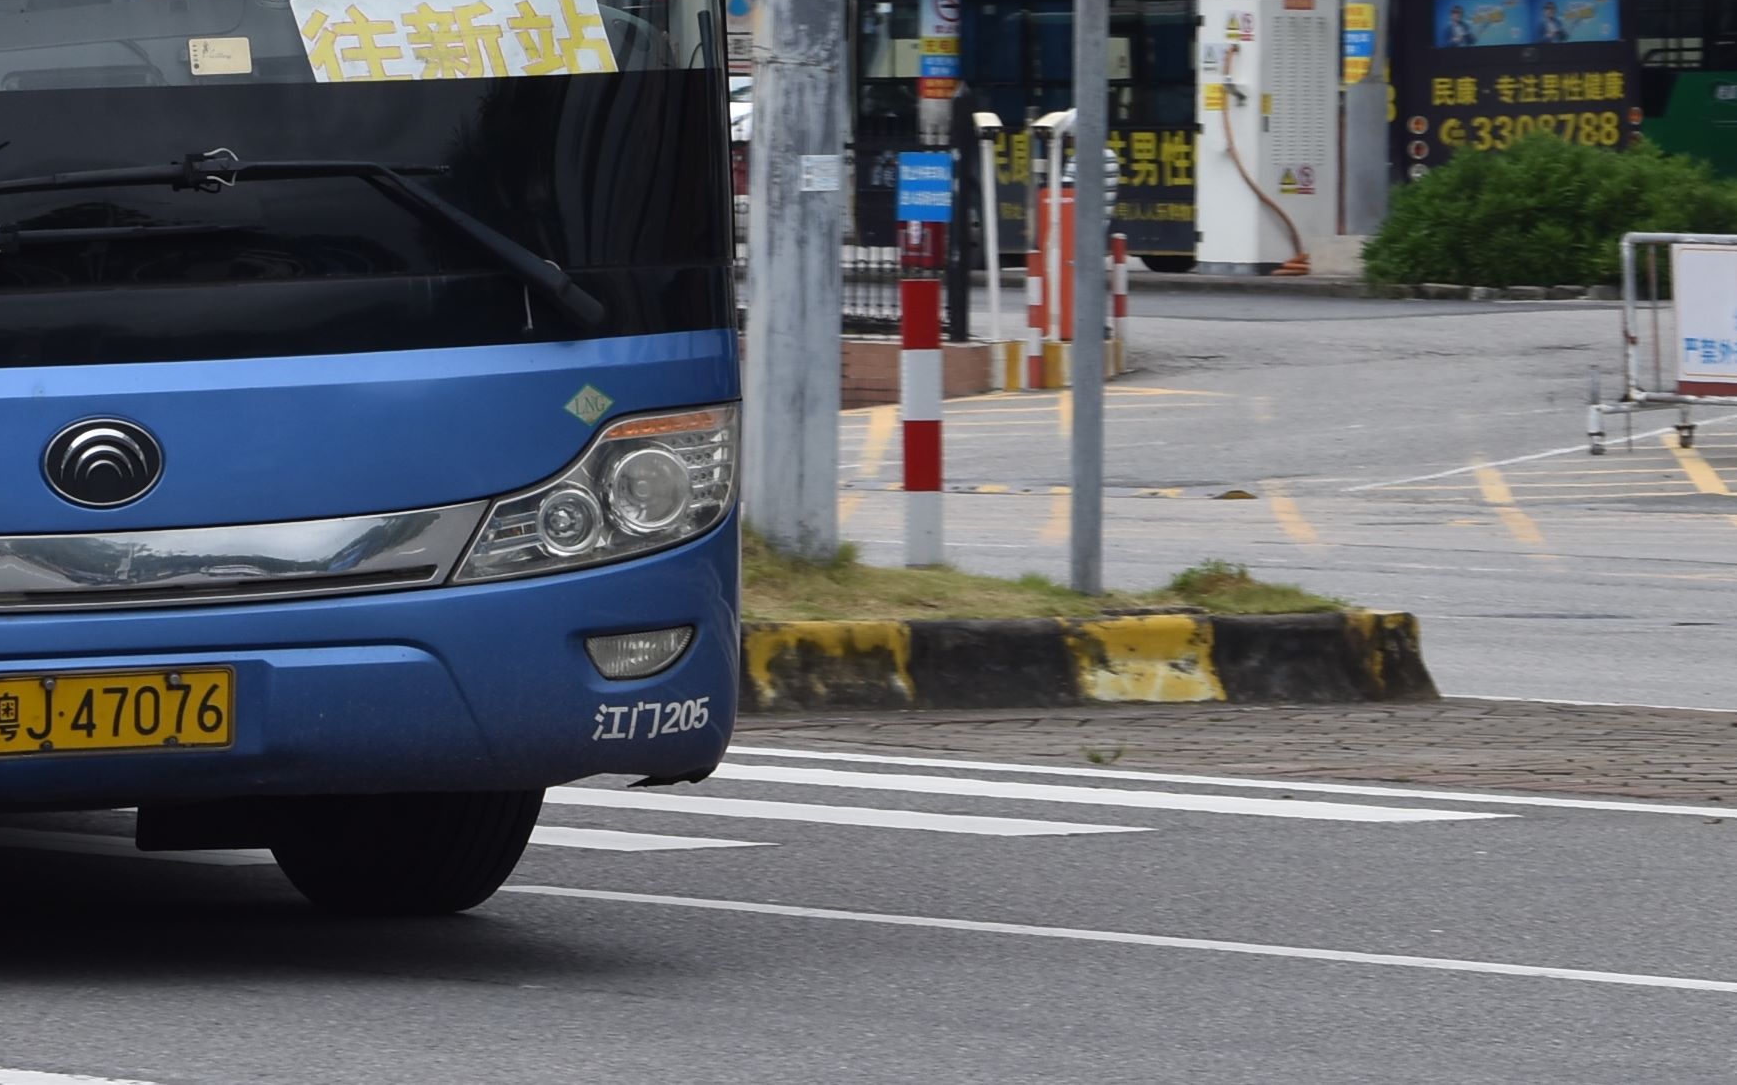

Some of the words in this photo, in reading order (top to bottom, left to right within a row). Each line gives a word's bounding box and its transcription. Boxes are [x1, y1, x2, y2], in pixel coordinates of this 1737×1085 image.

[1684, 337, 1737, 364] 严禁外
[592, 697, 709, 741] 江门205
